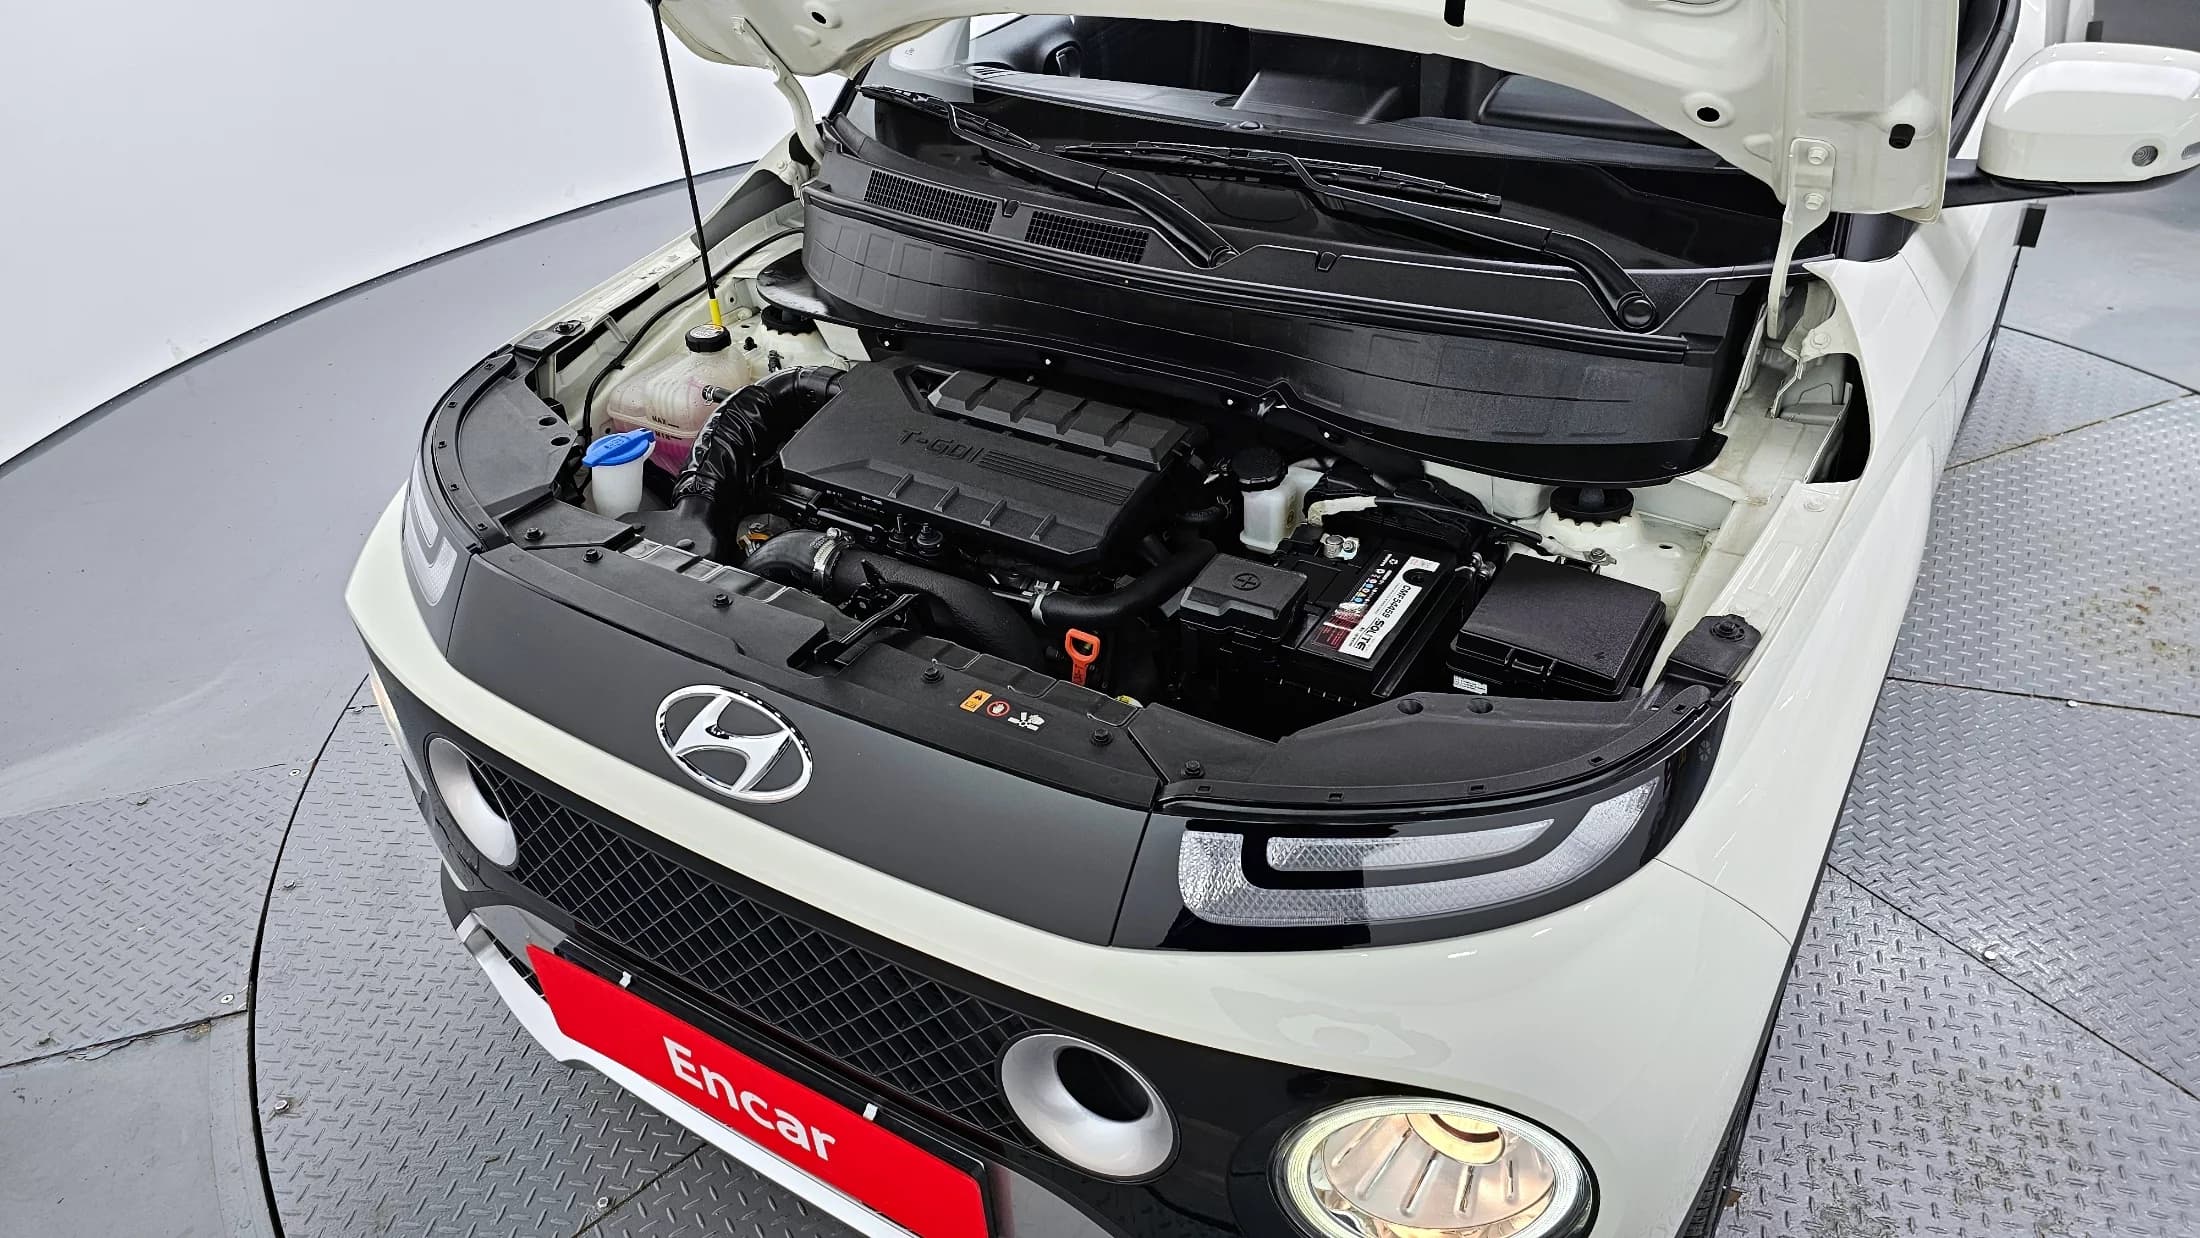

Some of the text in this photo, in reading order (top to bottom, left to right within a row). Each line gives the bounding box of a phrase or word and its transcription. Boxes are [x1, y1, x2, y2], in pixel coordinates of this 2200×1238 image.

[652, 415, 667, 425] MAX
[897, 430, 984, 463] T-GDI
[1356, 618, 1385, 651] SOLITE
[662, 1035, 836, 1161] Encar
